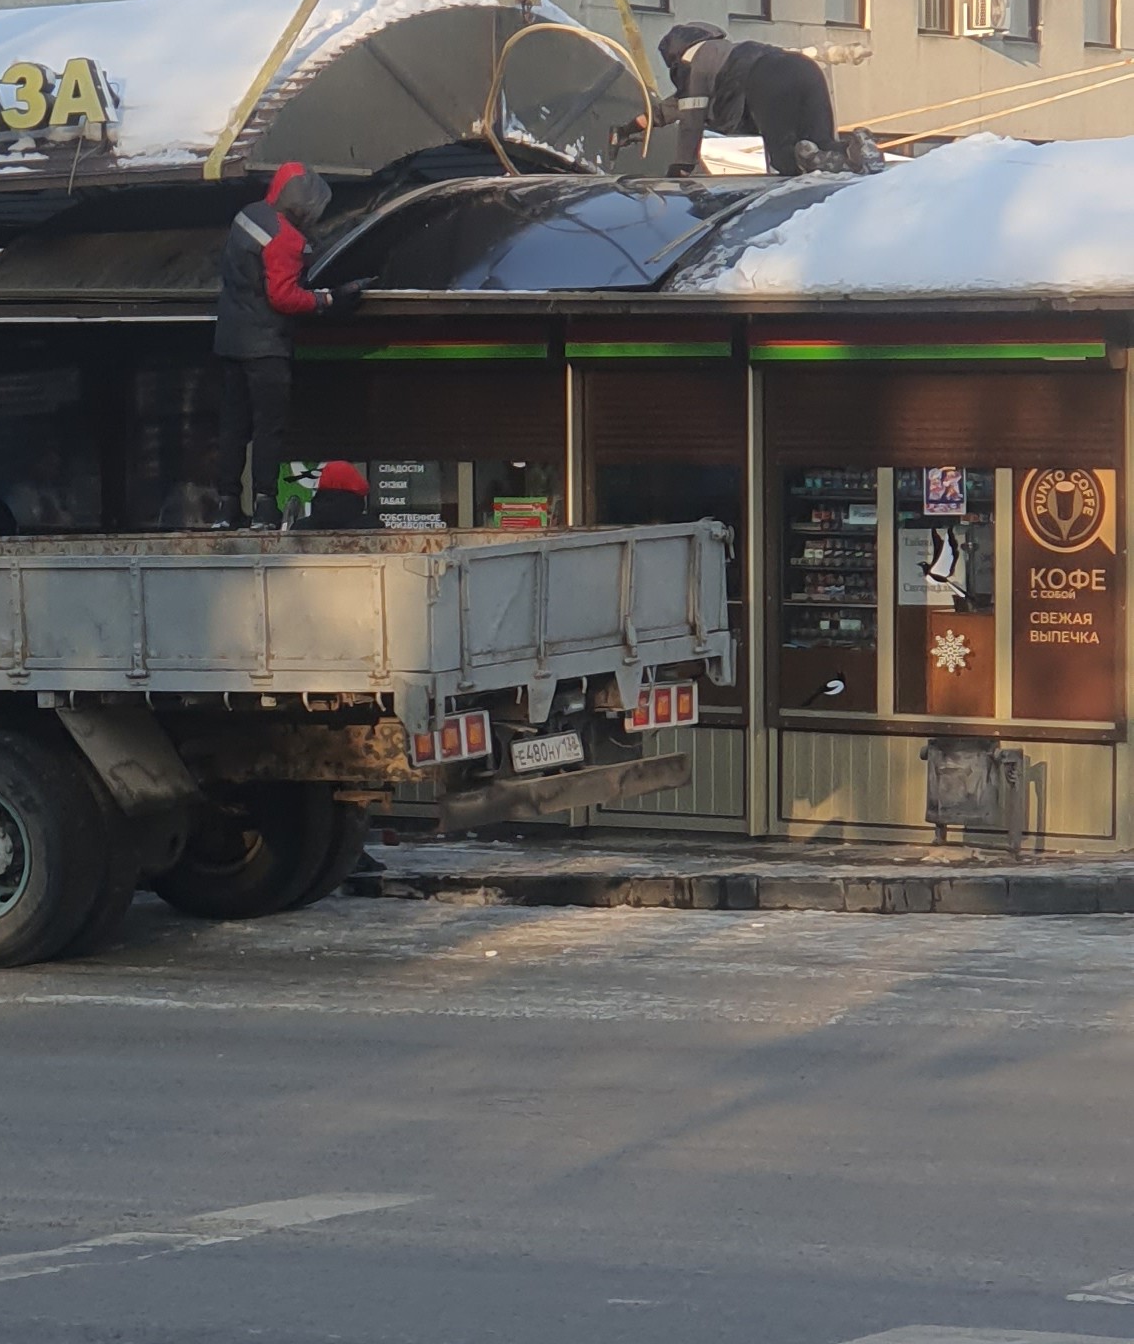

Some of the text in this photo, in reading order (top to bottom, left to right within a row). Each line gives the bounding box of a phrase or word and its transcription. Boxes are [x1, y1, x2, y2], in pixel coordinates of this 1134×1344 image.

[1035, 469, 1096, 517] PUNTO COFFE
[1030, 567, 1107, 591] КОФЕ
[1040, 588, 1076, 599] СОБОЙ
[1029, 611, 1093, 625] СВЕЖАЯ
[1029, 630, 1100, 644] ВЫПЕЧКА
